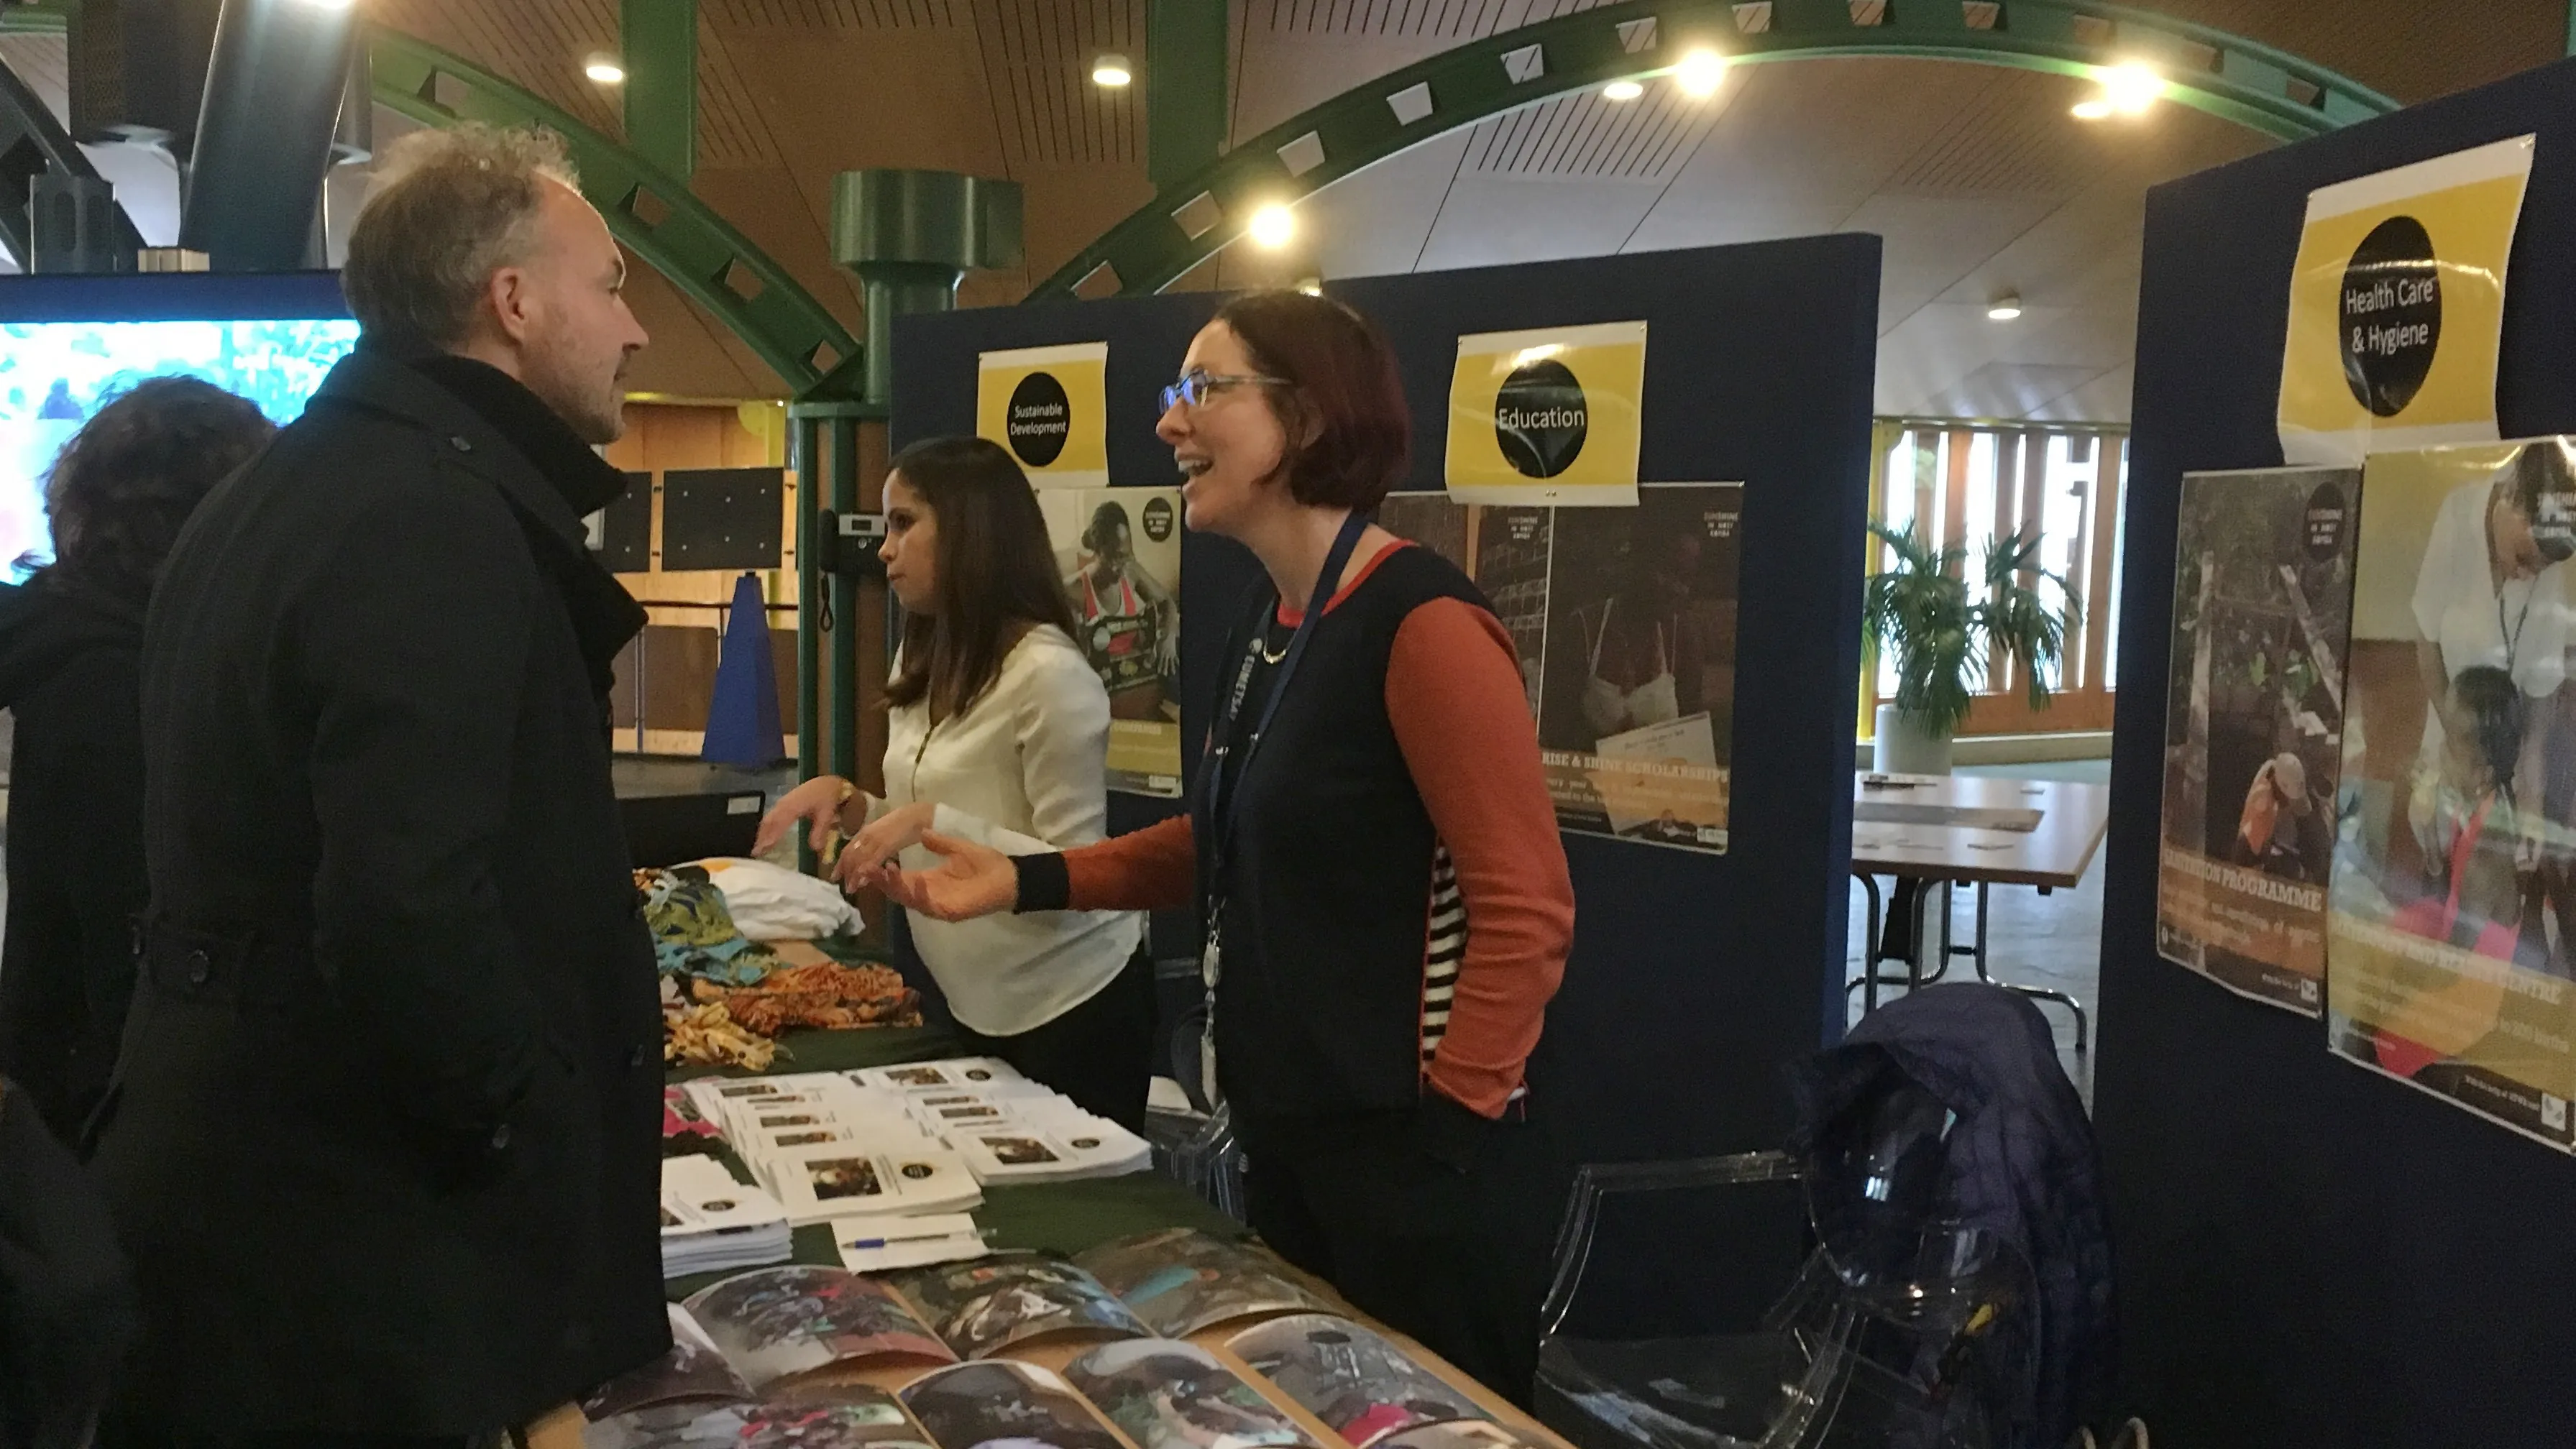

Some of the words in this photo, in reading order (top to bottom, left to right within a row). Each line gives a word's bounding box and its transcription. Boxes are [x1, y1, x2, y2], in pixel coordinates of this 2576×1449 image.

[2346, 281, 2395, 315] Health
[2398, 278, 2434, 306] Care
[2352, 326, 2365, 354] &
[2368, 321, 2429, 355] Hygiene
[1014, 402, 1063, 418] Sustainable
[1498, 406, 1585, 430] Education
[1009, 420, 1066, 436] Development
[1542, 751, 1569, 767] RISE
[1571, 753, 1581, 768] &
[2222, 868, 2322, 912] PROGRAMME
